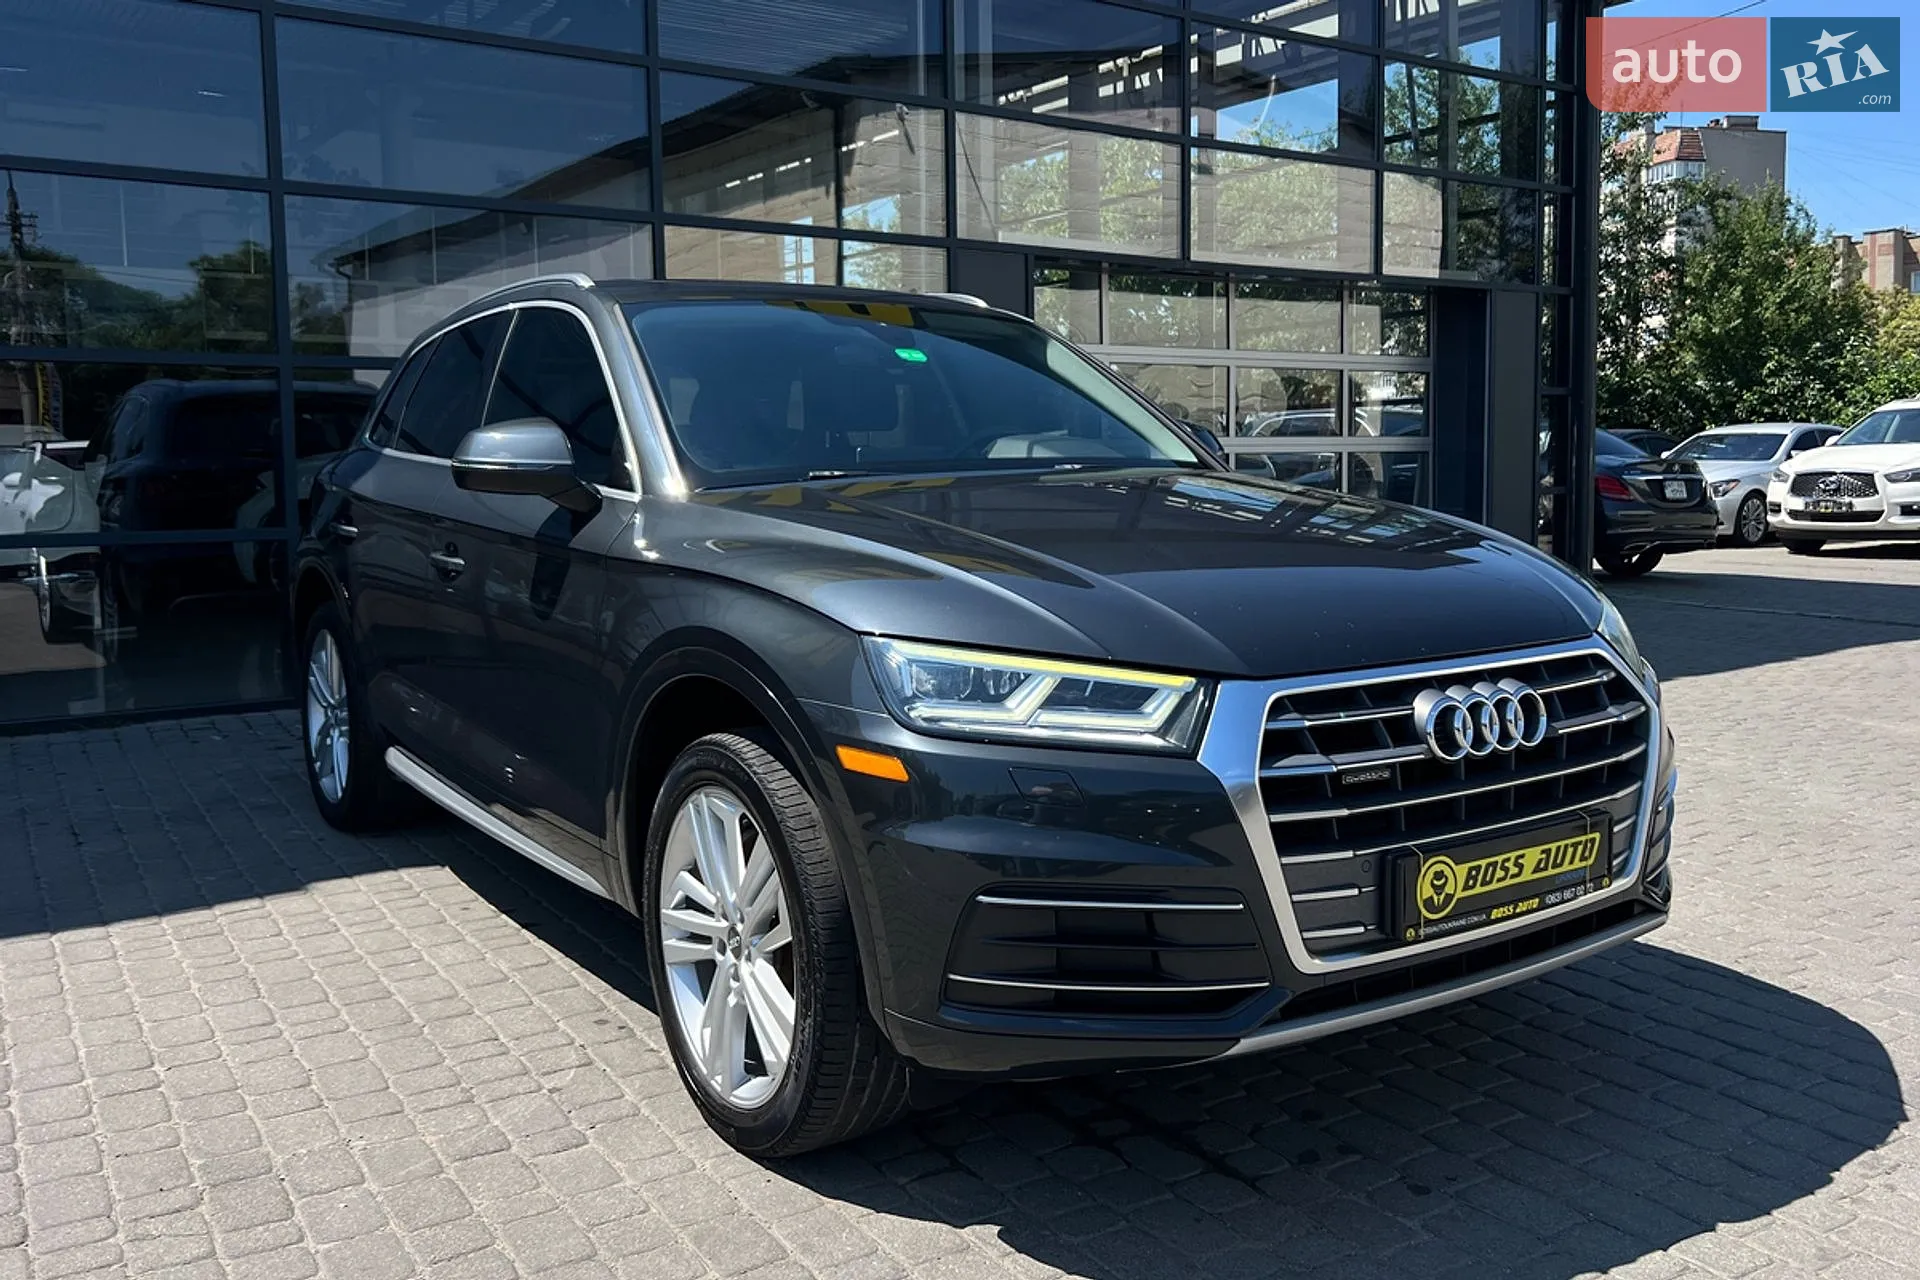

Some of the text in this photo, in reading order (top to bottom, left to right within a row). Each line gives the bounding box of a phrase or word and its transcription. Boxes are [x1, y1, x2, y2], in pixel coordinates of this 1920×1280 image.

[1461, 837, 1597, 892] BOSS AUTO
[1490, 898, 1539, 920] BOSS AUTO
